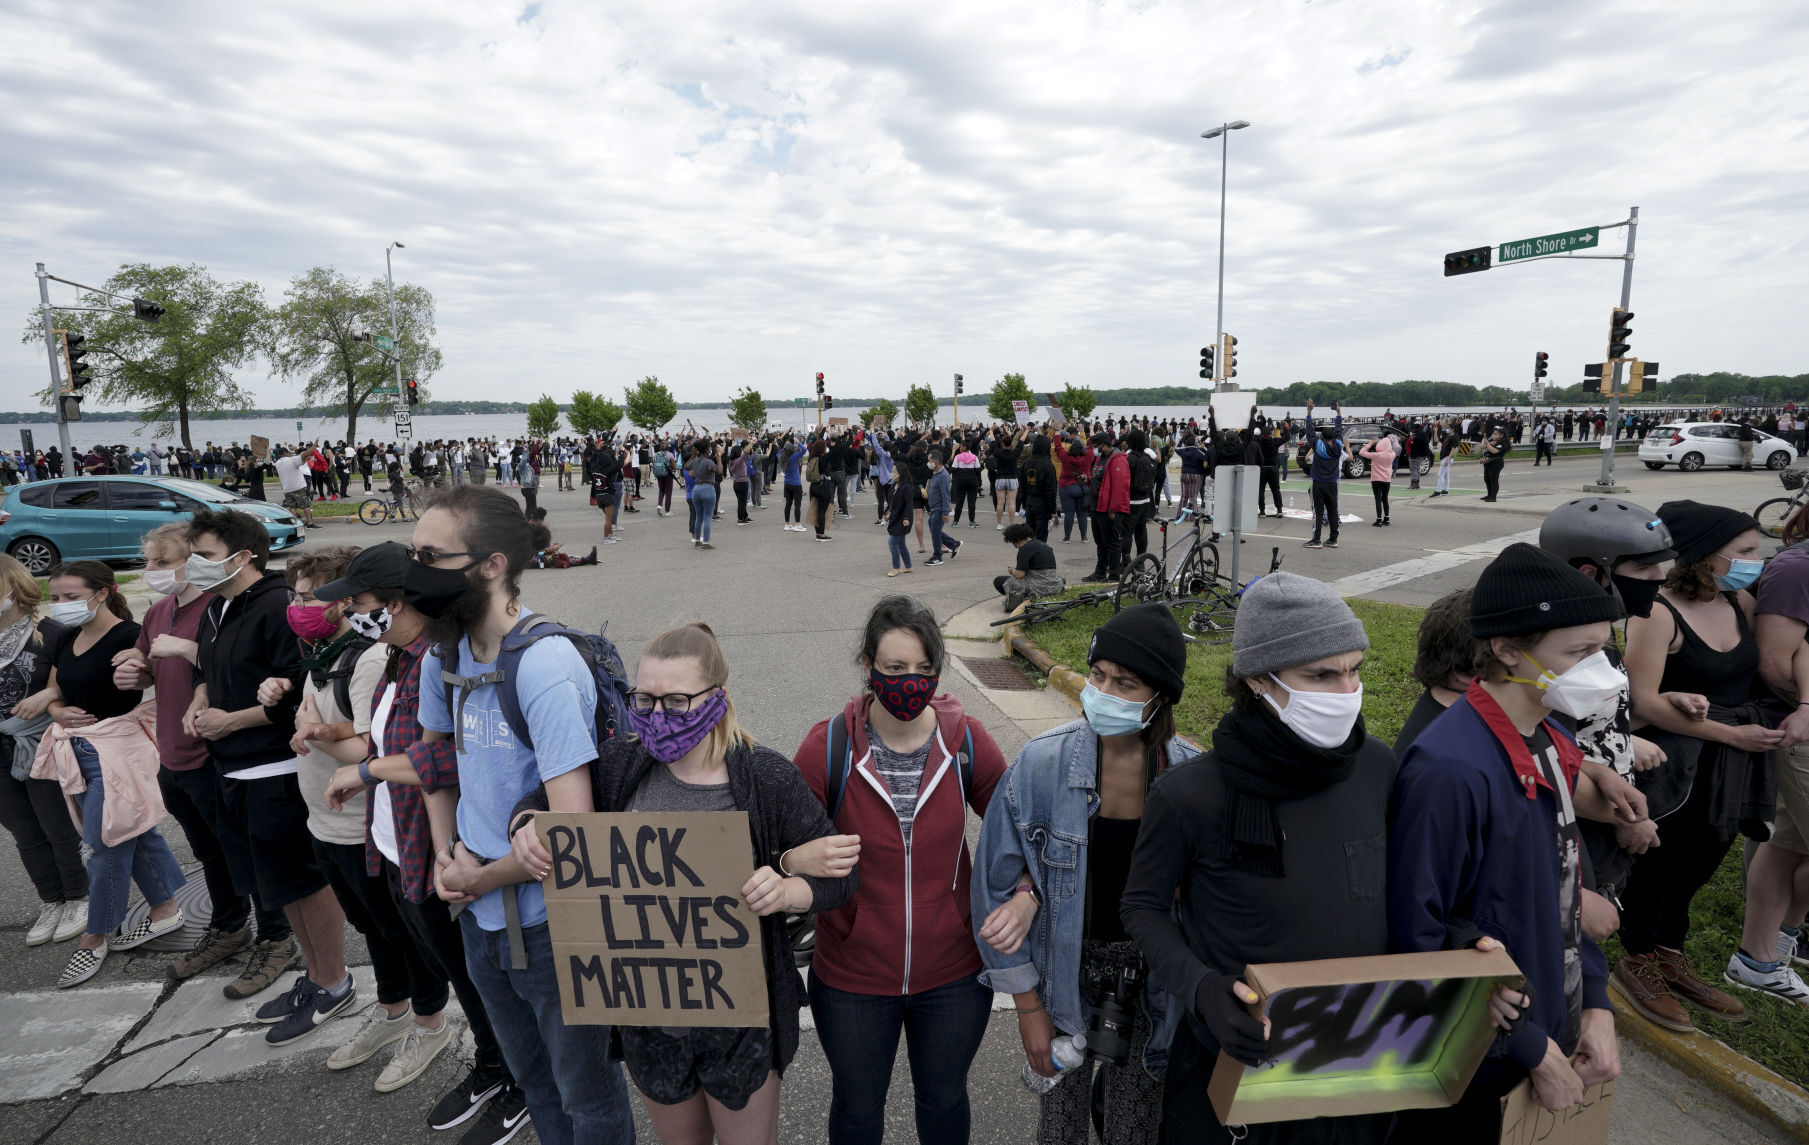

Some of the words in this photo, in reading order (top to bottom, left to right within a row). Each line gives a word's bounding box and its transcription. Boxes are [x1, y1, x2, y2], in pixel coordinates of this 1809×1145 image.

[1504, 241, 1532, 259] North
[1536, 238, 1566, 254] Shore
[1569, 236, 1577, 245] Dr
[396, 413, 409, 422] 151
[595, 478, 602, 486] 3
[546, 825, 705, 890] BLACK
[599, 895, 750, 950] LIVES
[569, 955, 735, 1010] MATTER
[1269, 977, 1468, 1074] BLM
